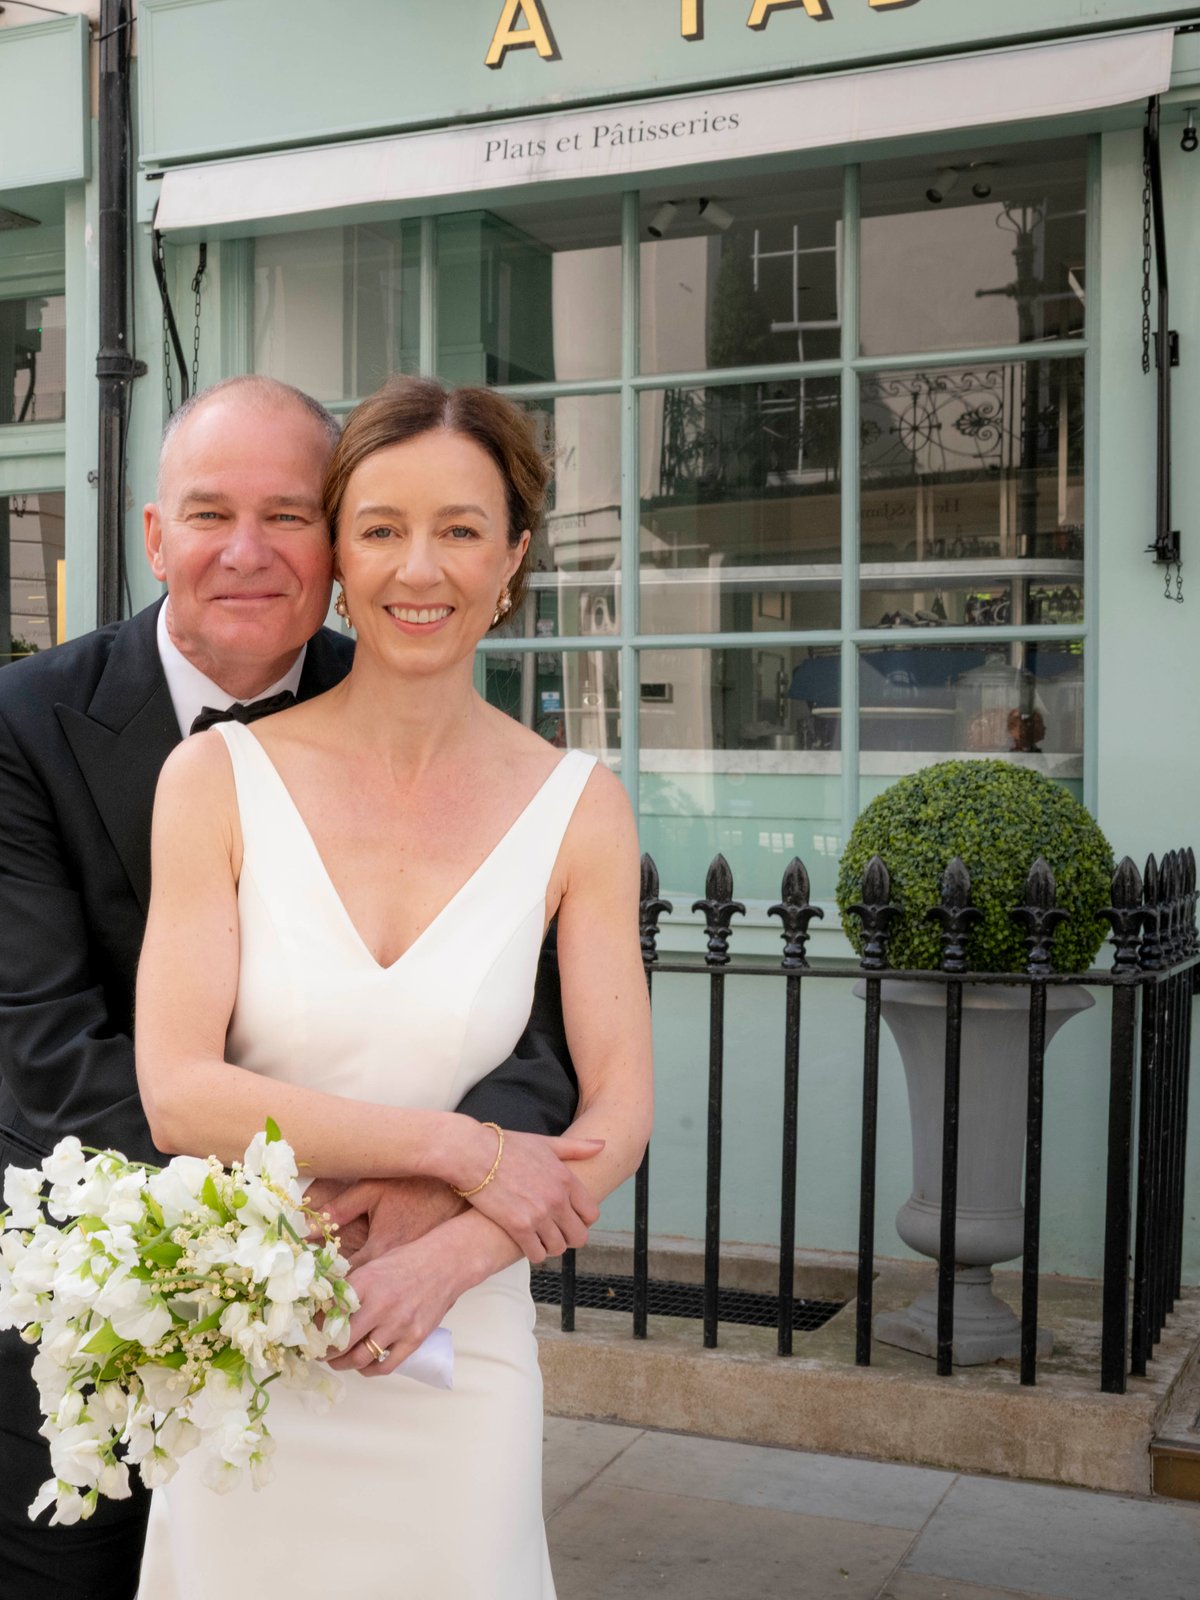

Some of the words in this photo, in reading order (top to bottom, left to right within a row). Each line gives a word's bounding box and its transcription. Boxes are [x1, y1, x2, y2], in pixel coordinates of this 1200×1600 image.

[484, 138, 547, 163] Plats
[556, 132, 583, 153] et
[592, 110, 740, 149] Pâtisseries
